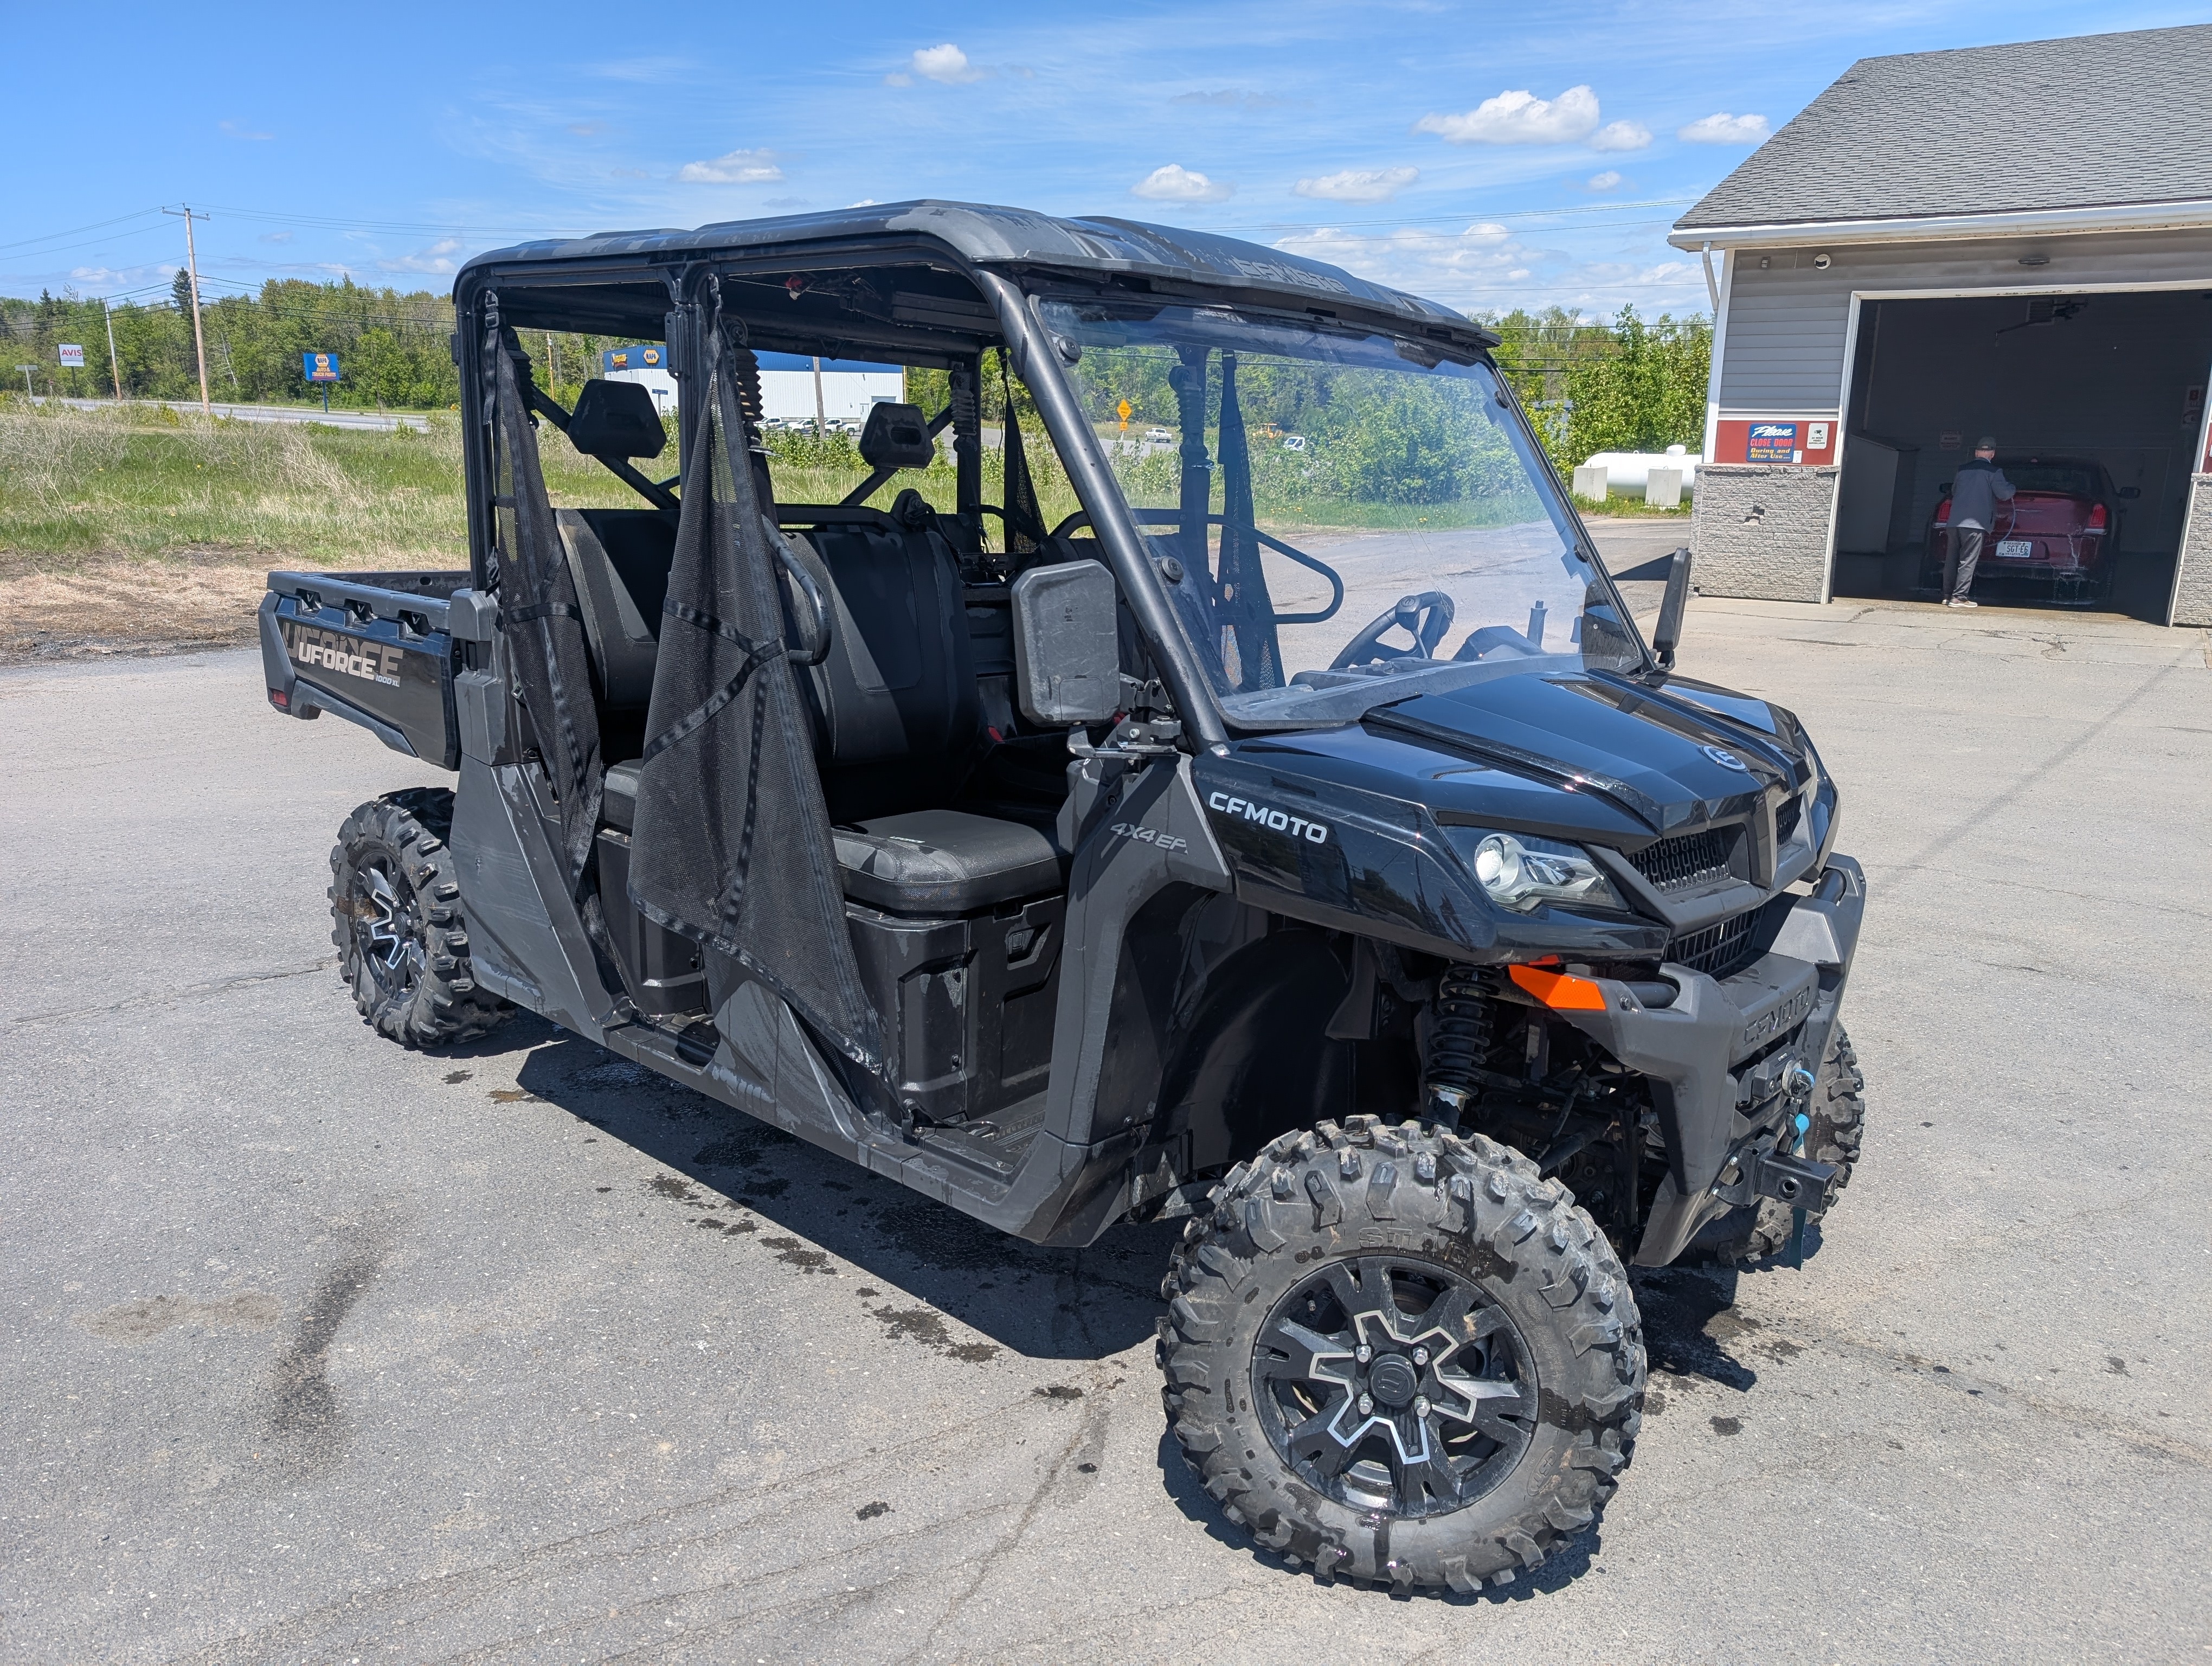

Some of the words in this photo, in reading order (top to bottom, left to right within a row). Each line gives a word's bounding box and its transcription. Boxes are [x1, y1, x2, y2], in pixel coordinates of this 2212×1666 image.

[1750, 438, 1772, 447] CLOSE
[1774, 438, 1793, 447] DOOR
[1751, 425, 1793, 438] Please
[298, 642, 376, 681] UFORCE
[375, 675, 392, 685] 1000
[391, 680, 400, 688] XL
[1110, 823, 1157, 842] 4X4
[1209, 791, 1328, 844] CFMOTO
[1744, 985, 1811, 1047] CFMOTO
